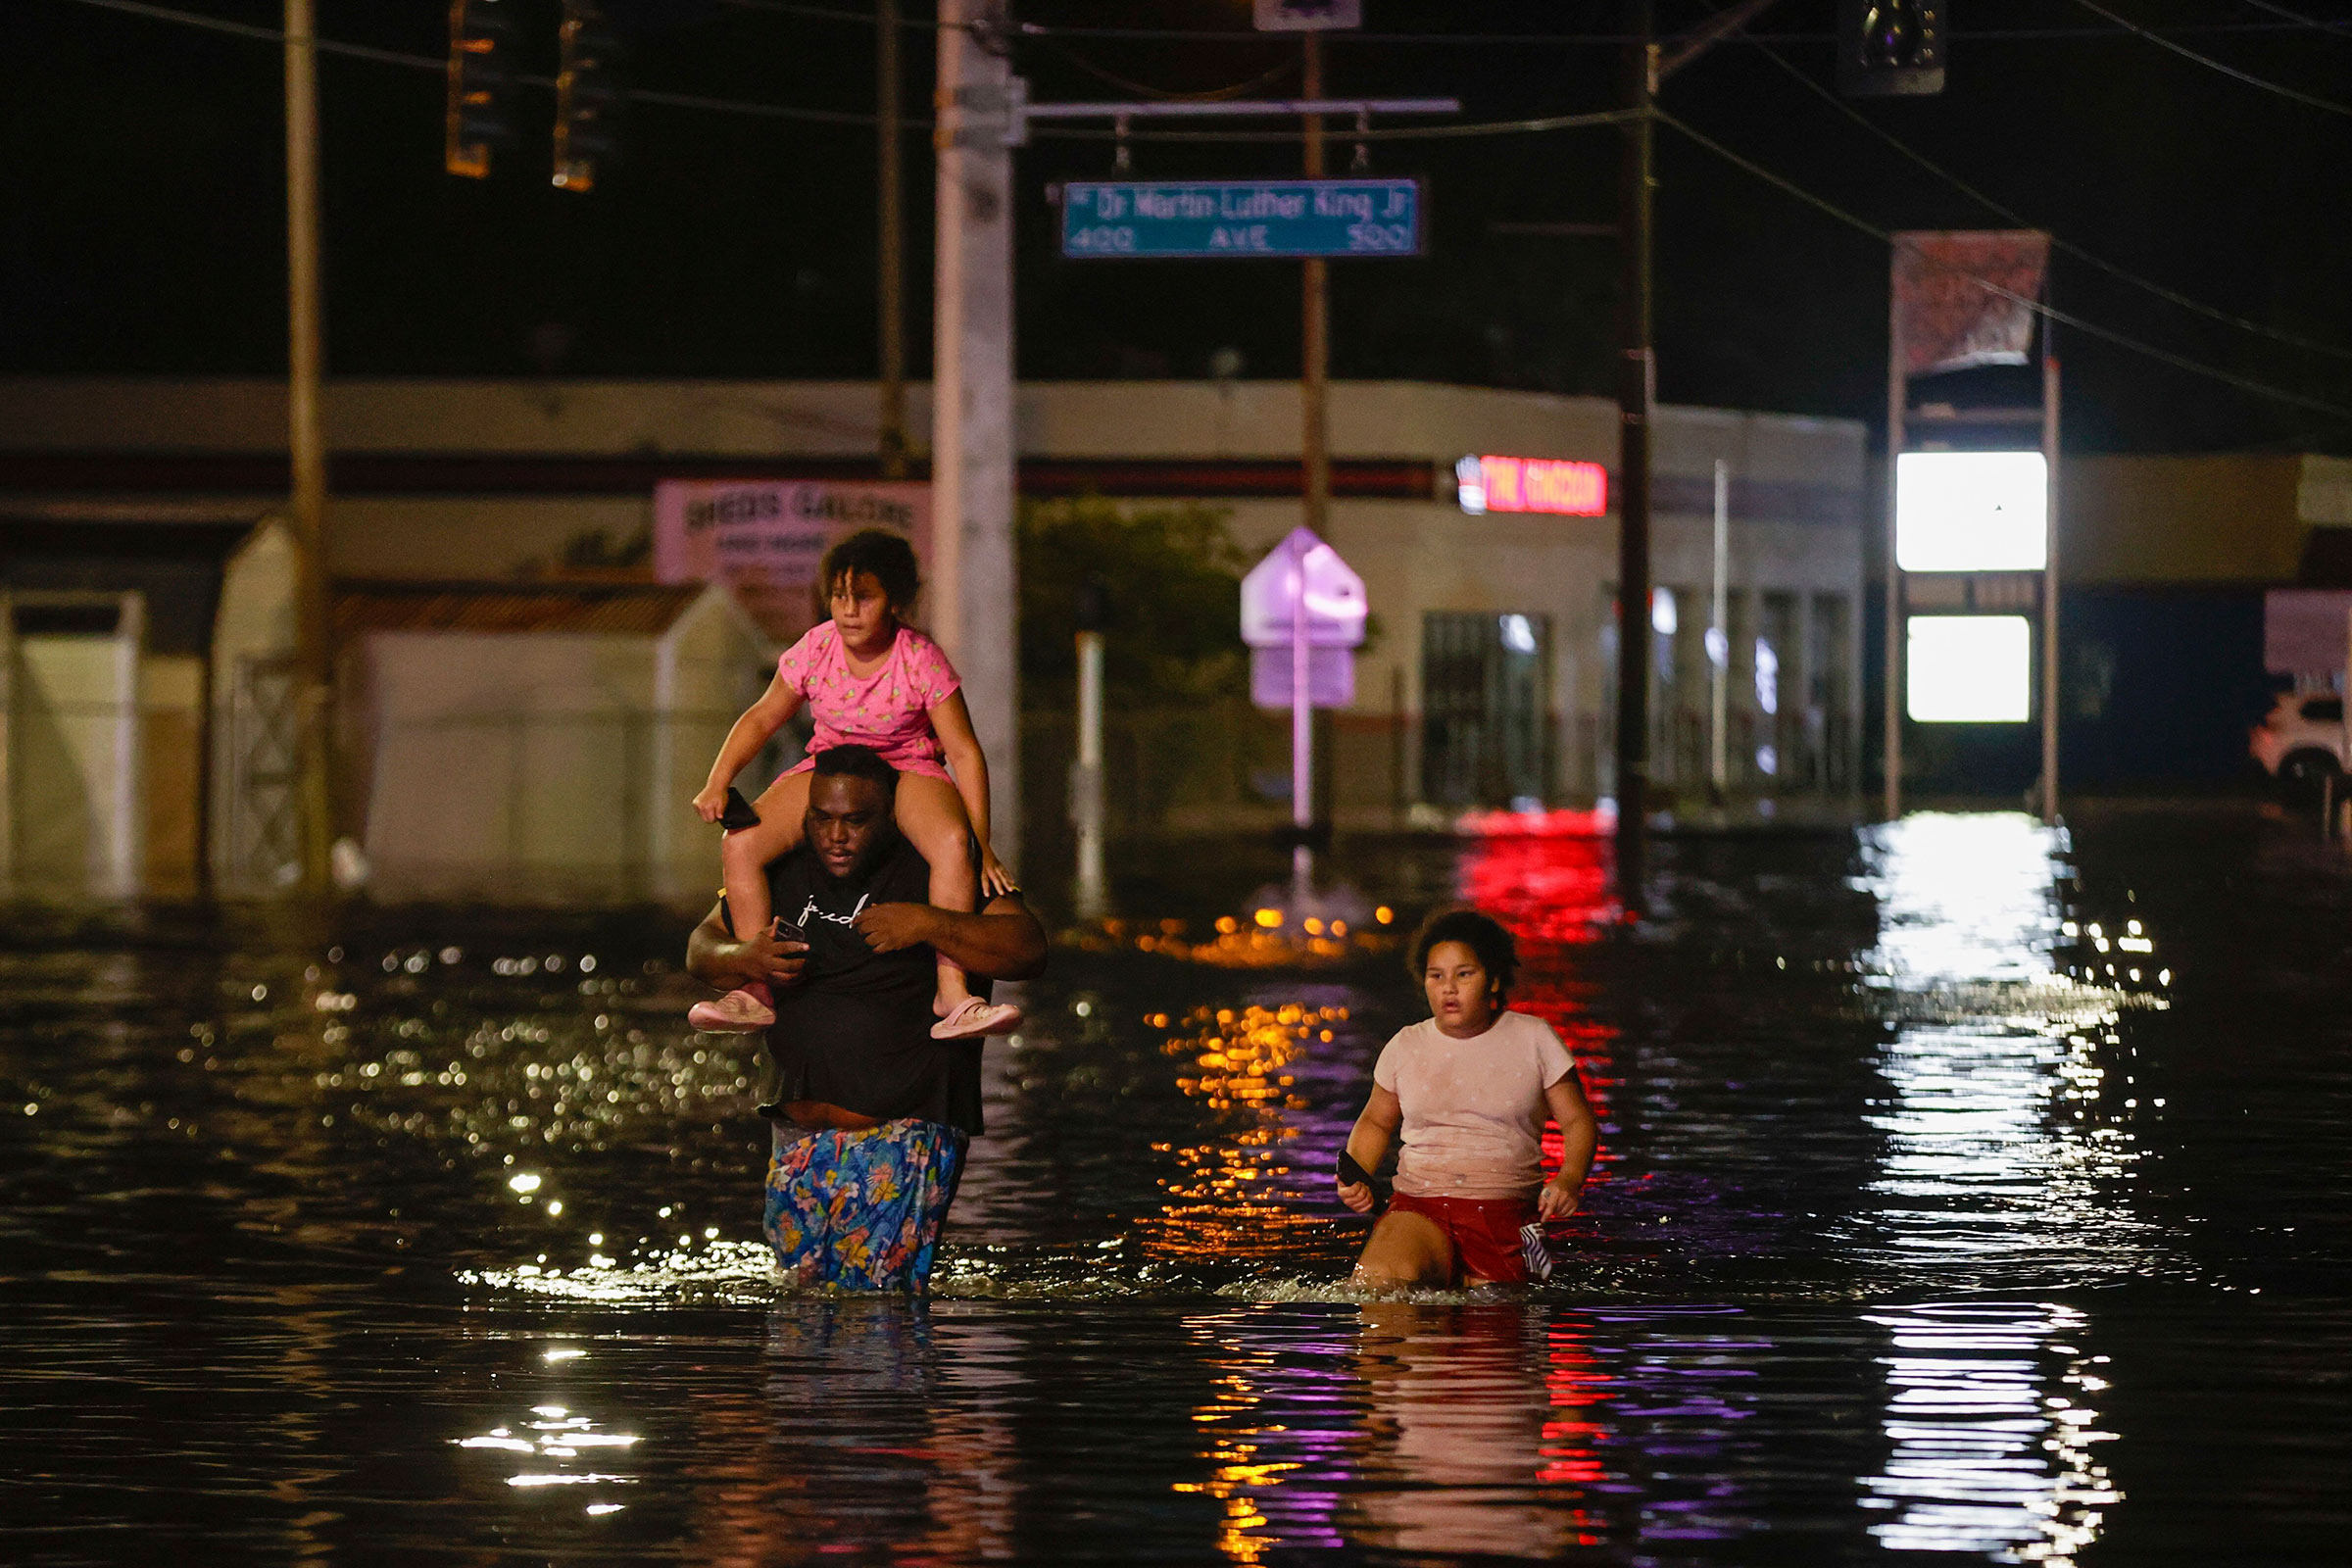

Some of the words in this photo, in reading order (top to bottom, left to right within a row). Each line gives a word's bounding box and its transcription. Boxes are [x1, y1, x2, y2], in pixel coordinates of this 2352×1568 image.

[1134, 186, 1217, 219] Martin
[1222, 186, 1307, 220] Luther
[1314, 185, 1372, 224] King
[1381, 184, 1407, 218] Jr
[1209, 225, 1268, 249] AVE
